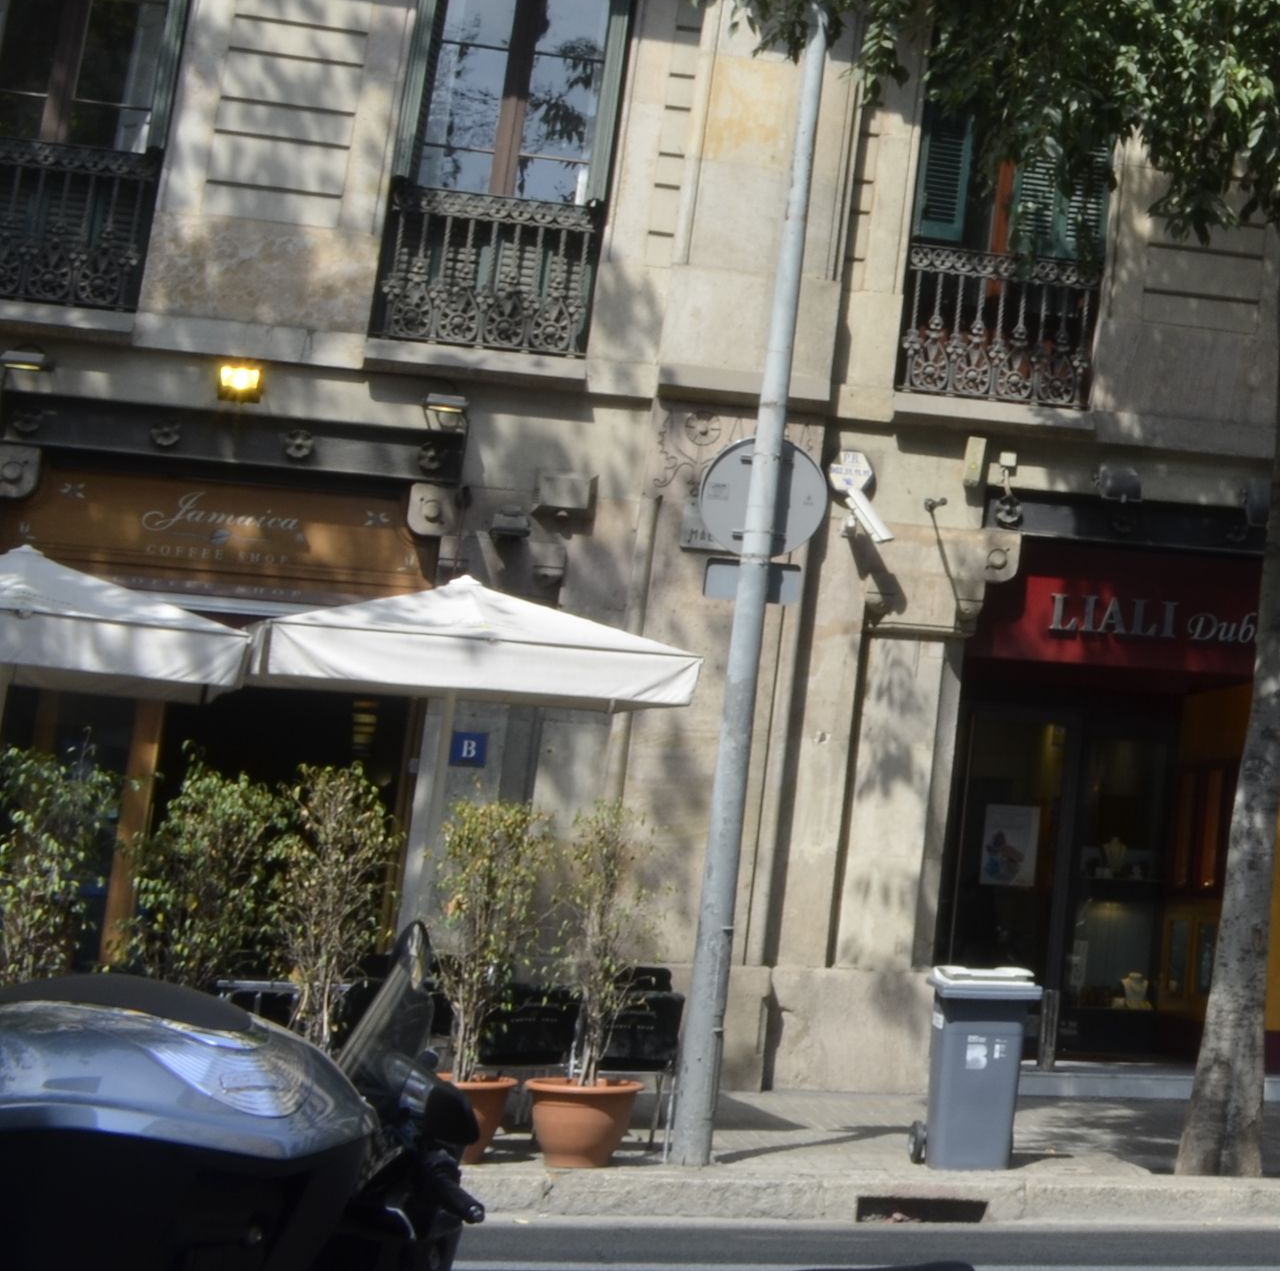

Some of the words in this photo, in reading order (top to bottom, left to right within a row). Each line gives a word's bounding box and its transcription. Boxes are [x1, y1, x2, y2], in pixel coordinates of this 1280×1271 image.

[142, 491, 299, 531] Jamaica
[146, 544, 225, 561] COFFEE
[238, 551, 289, 563] SHOP
[1048, 592, 1179, 639] LIALI
[1187, 612, 1258, 644] Dub
[462, 740, 476, 758] B
